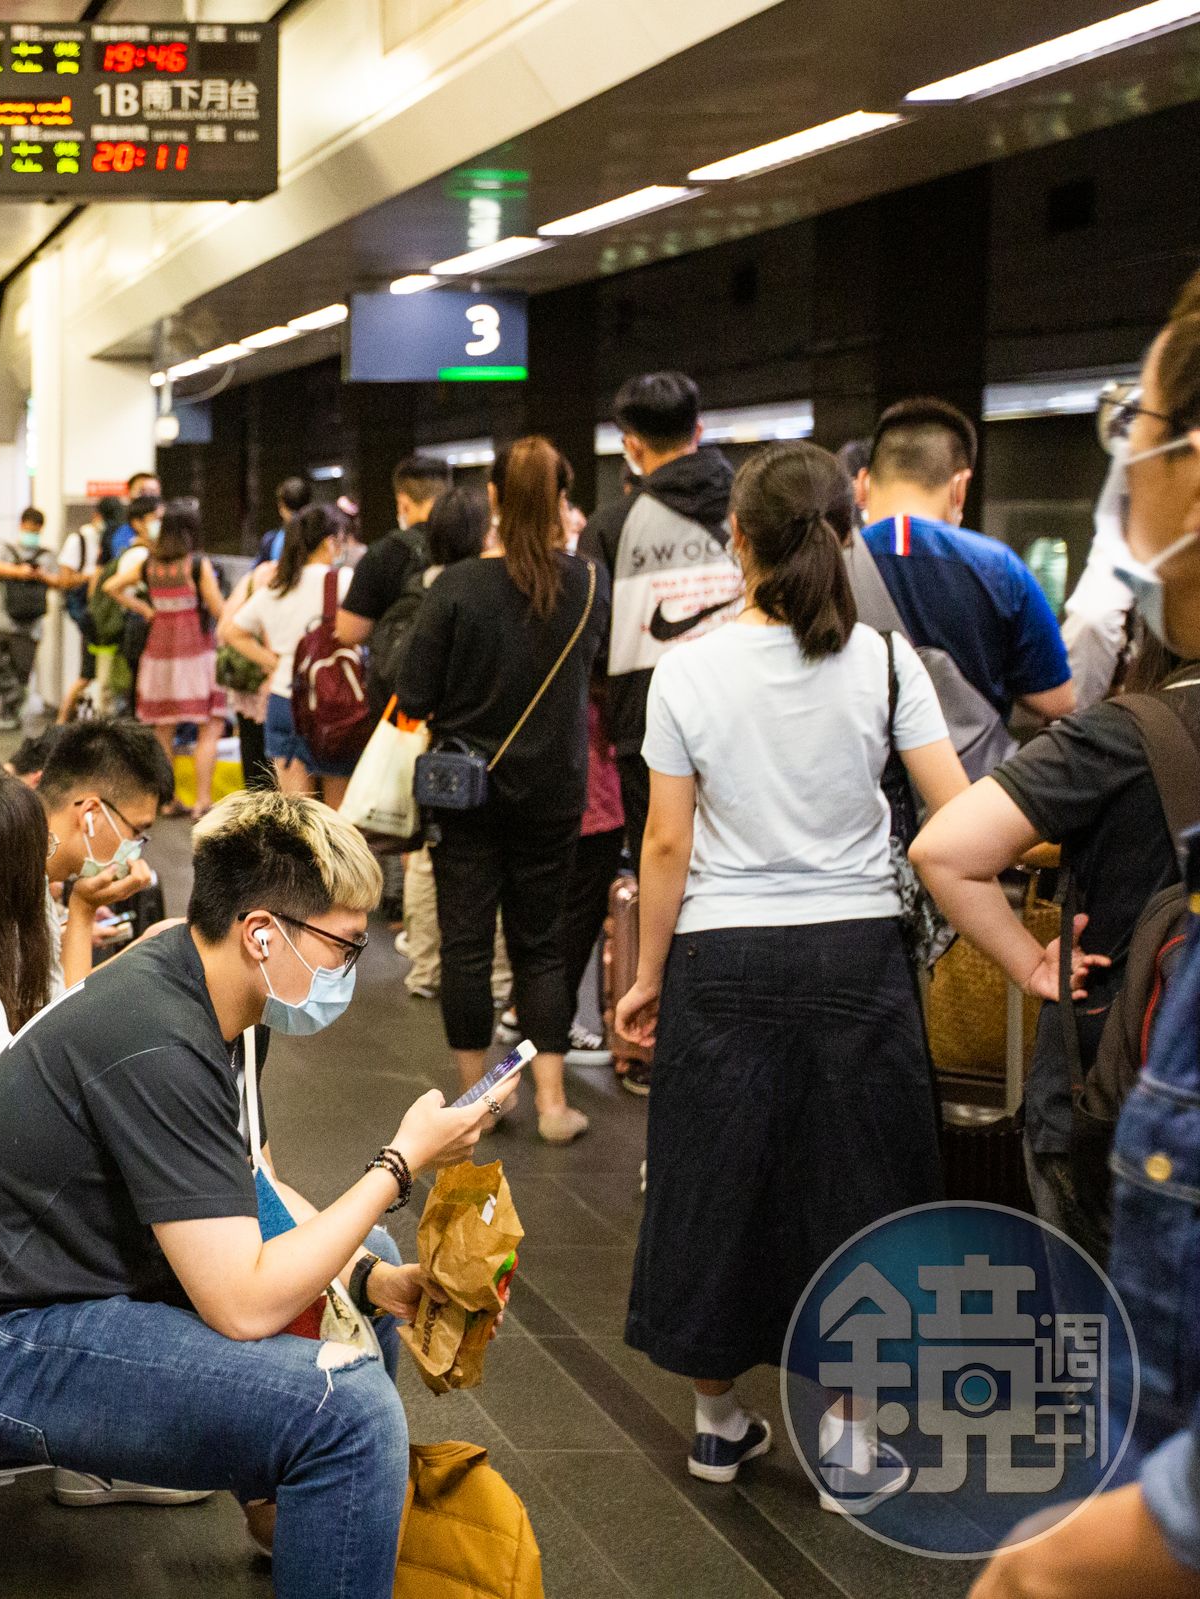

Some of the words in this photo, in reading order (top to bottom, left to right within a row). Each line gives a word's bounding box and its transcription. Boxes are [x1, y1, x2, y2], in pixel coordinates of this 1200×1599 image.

[103, 41, 189, 73] 19:46
[93, 82, 140, 118] 1B
[92, 141, 189, 172] 20:11
[465, 304, 500, 356] 3
